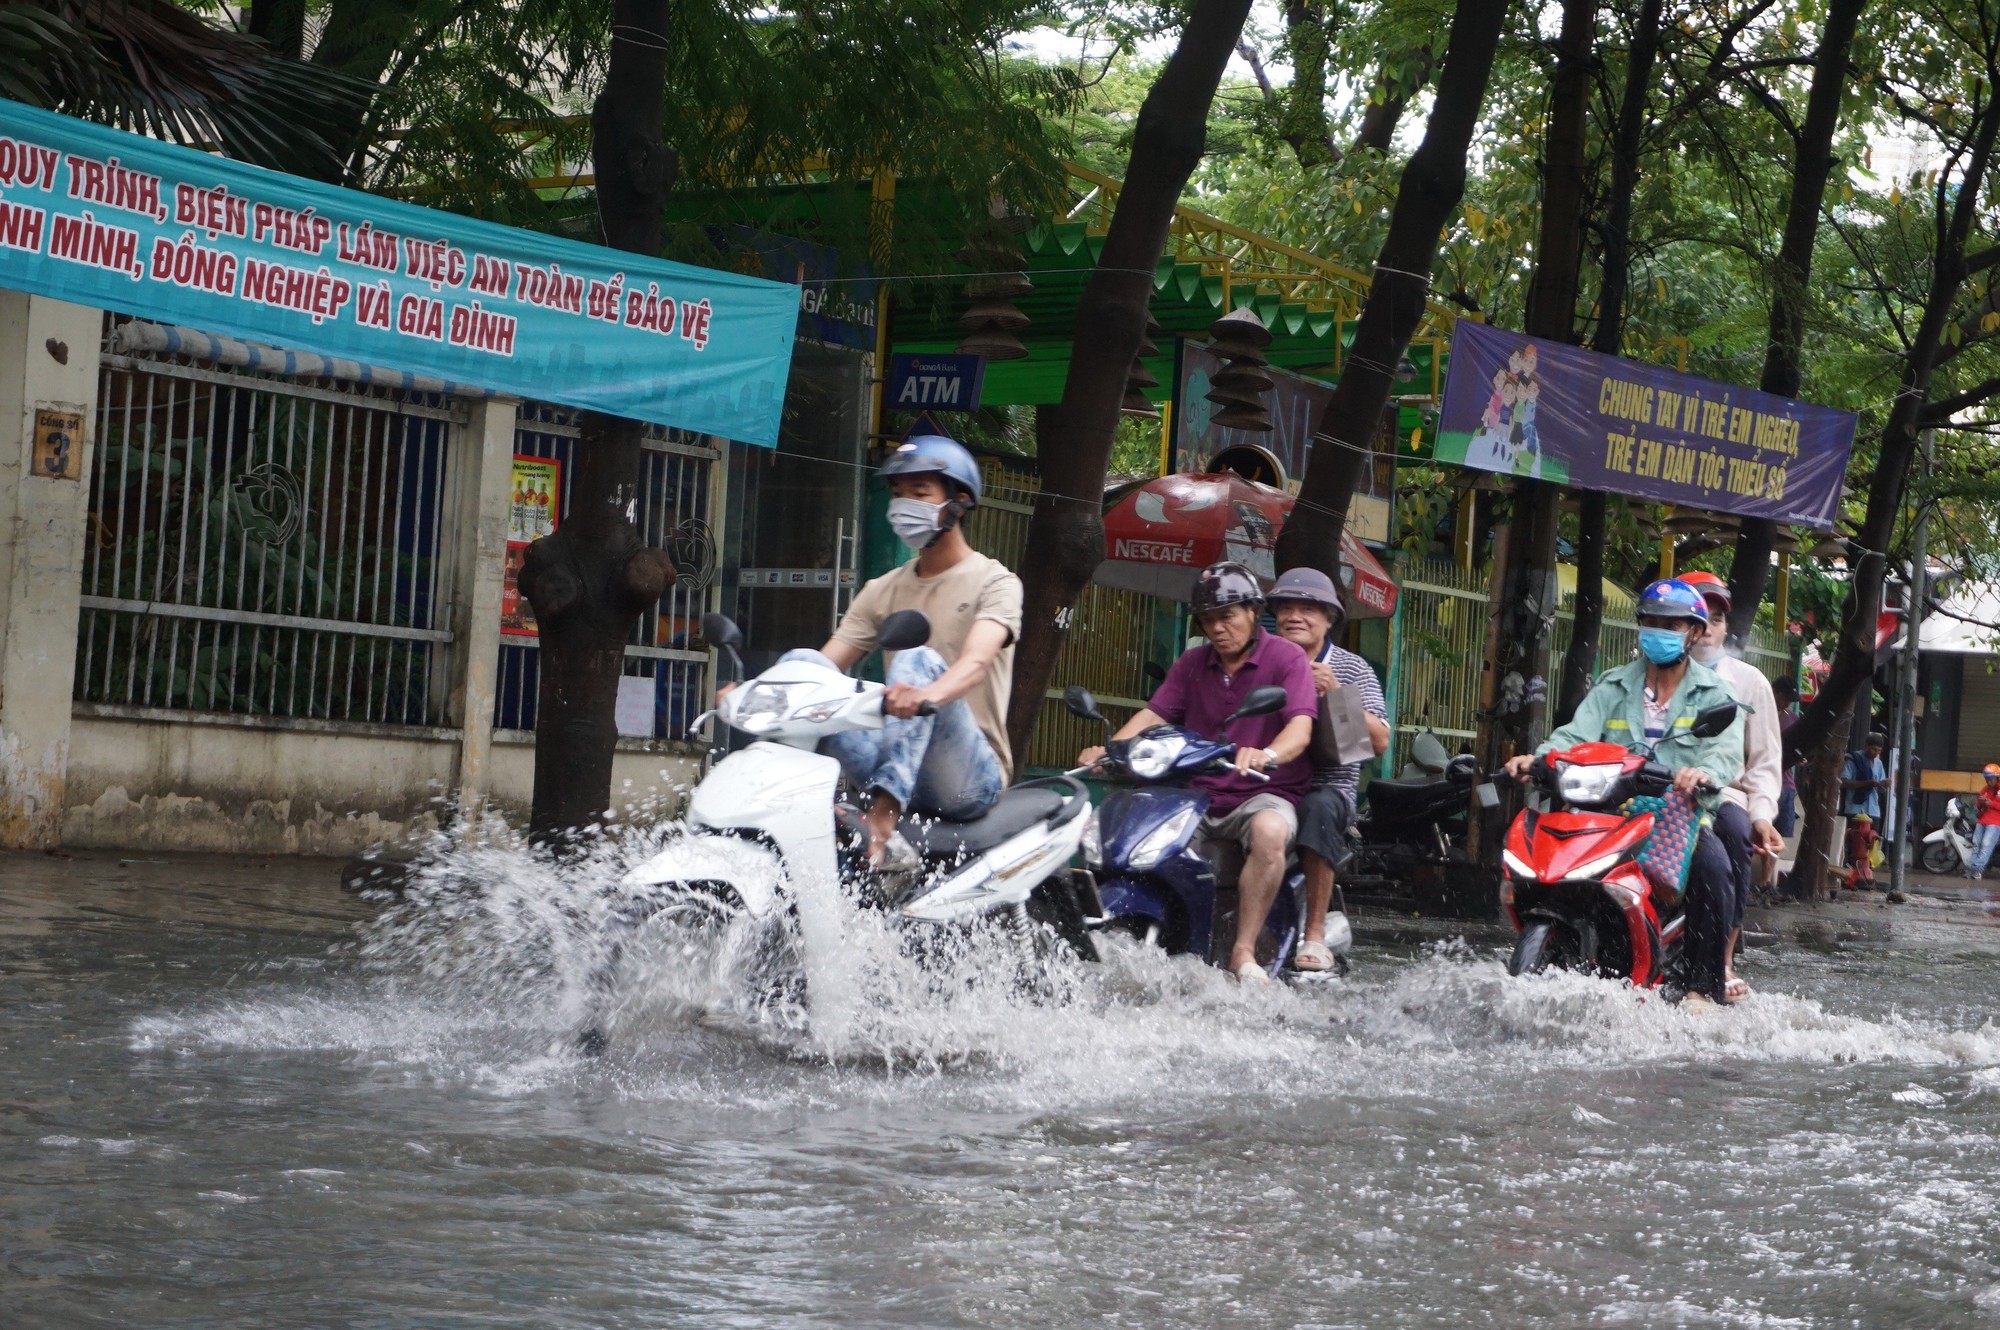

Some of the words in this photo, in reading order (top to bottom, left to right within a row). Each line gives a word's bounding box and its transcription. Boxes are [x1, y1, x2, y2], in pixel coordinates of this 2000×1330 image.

[0, 139, 59, 189] QUY
[176, 184, 247, 238] BIỆN
[254, 204, 330, 253] PHÁP
[405, 238, 465, 290] VIỆC
[469, 255, 509, 296] AN
[516, 265, 583, 313] TOÀN
[588, 273, 624, 322] ĐỂ
[625, 284, 676, 333] BẢO
[682, 300, 711, 349] VỆ
[50, 213, 142, 278] MÌNH,
[152, 232, 236, 294] ĐỒNG
[243, 260, 350, 322] NGHIỆP
[358, 282, 390, 328] VÀ
[399, 295, 443, 340] GIA
[450, 302, 515, 354] ĐÌNH
[898, 375, 961, 404] ATM
[1598, 376, 1654, 424] CHUNG
[1655, 389, 1683, 429] TAY
[1682, 389, 1700, 434] VÌ
[1700, 392, 1730, 440] TRẺ
[1727, 406, 1753, 445] EM
[44, 431, 71, 473] 3
[1605, 423, 1637, 474] TRẺ
[1635, 438, 1663, 478] EM
[1662, 439, 1696, 485] DÂN
[1696, 445, 1725, 496] TỘC
[1726, 448, 1767, 497] THIỂU
[1765, 455, 1790, 501] SỐ
[1114, 538, 1194, 563] NESCAFÉ
